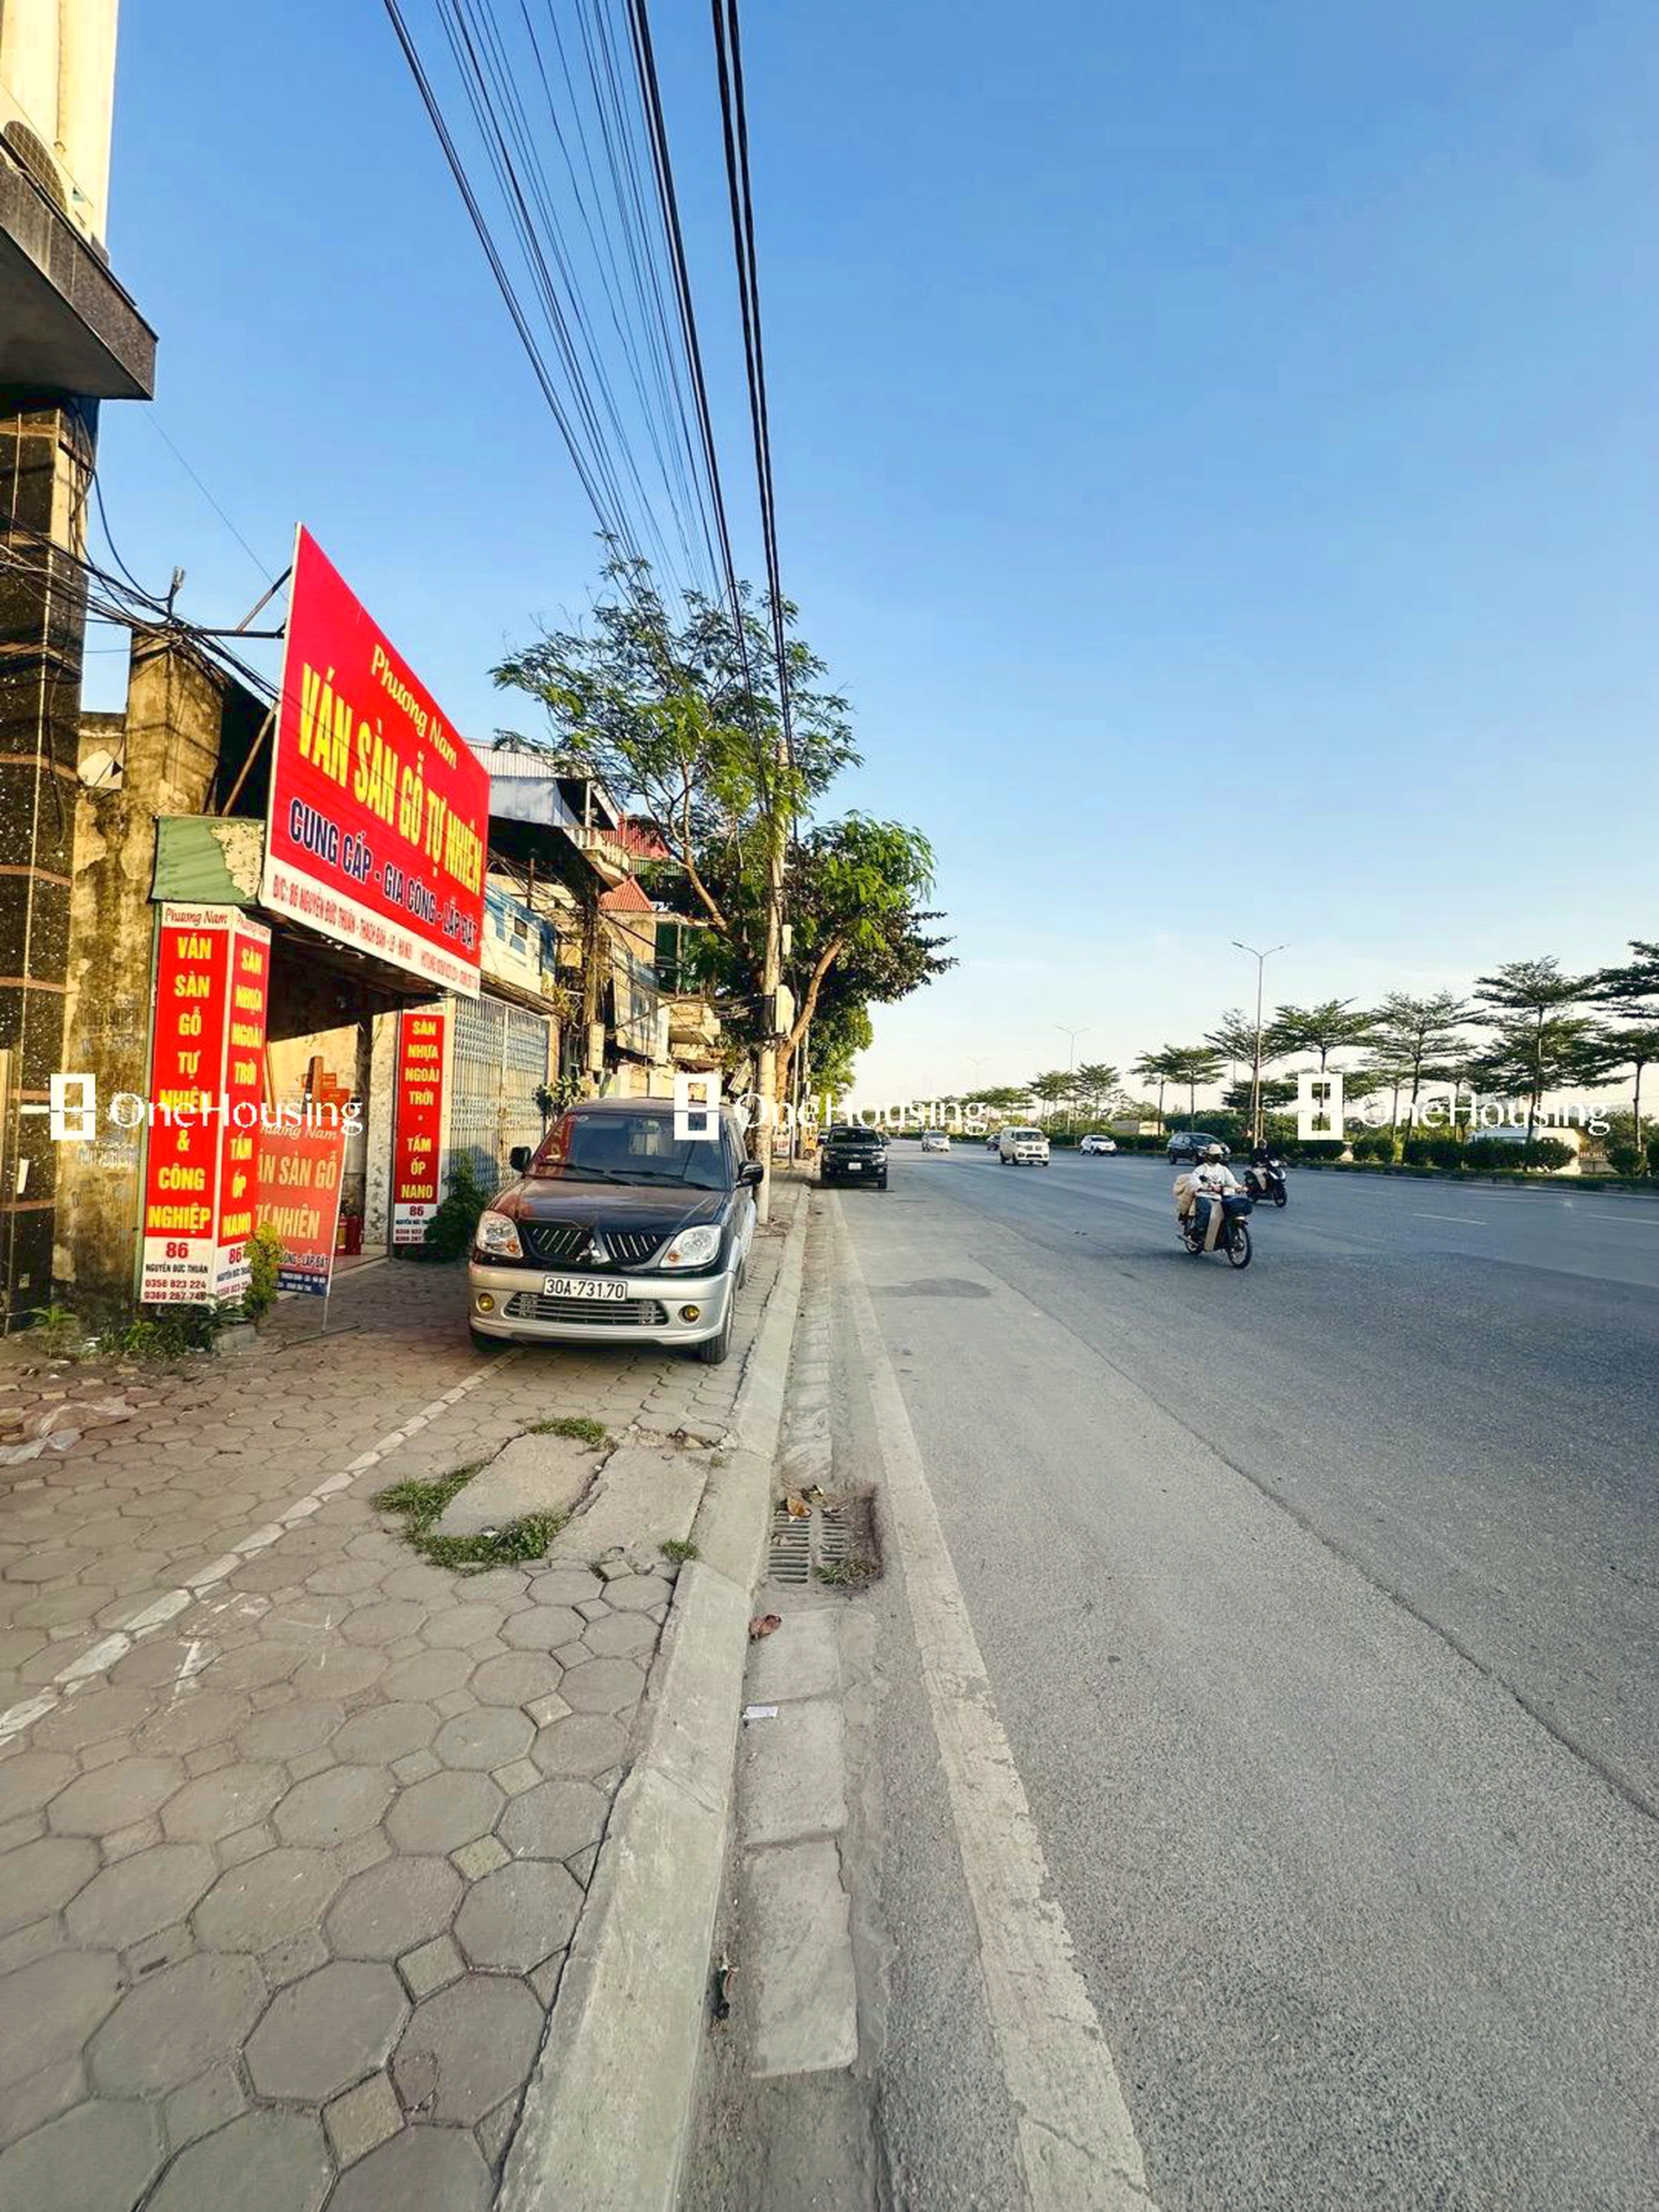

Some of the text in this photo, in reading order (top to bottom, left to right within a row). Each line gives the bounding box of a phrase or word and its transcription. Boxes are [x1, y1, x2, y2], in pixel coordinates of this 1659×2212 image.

[371, 644, 457, 770] Phương Nam
[300, 662, 483, 897] VÁN SÀN GỖ TỰ NHIÊN
[289, 796, 339, 866] CUNG
[342, 831, 372, 884] CẤP
[383, 861, 403, 906] GIA
[407, 877, 436, 926] CÔNG
[442, 897, 461, 938] LẮP
[164, 908, 227, 926] Phương Nam
[177, 933, 212, 959] VÁN
[241, 947, 263, 975] SÀN
[174, 970, 211, 998] SÀN
[235, 985, 263, 1015] NHỰA
[178, 1005, 202, 1036] GỖ
[412, 1017, 436, 1036] SÀN
[231, 1023, 263, 1049] NGOÀI
[177, 1049, 201, 1080] TỰ
[408, 1043, 439, 1062] NHỰA
[234, 1058, 256, 1086] TRỜI
[404, 1066, 440, 1081] NGOÀI
[408, 1087, 434, 1106] TRỜI
[177, 1129, 190, 1152] &
[231, 1131, 252, 1160] TẤM
[407, 1133, 431, 1152] TẤM
[158, 1163, 206, 1191] CÔNG
[279, 1150, 312, 1187] SÀN
[314, 1150, 337, 1189] GỖ
[410, 1157, 427, 1175] ỐP
[231, 1169, 247, 1199] ỐP
[401, 1184, 433, 1199] NANO
[148, 1202, 211, 1234] NGHIỆP
[272, 1202, 320, 1239] NHIÊN
[409, 1206, 424, 1216] 86
[222, 1213, 251, 1238] NANO
[166, 1242, 189, 1258] 86
[229, 1248, 242, 1264] 86
[145, 1261, 171, 1272] NGUYỄN
[187, 1263, 208, 1274] THUẬN
[145, 1279, 206, 1290] 0358 823 224
[546, 1279, 624, 1299] 30A-731.70
